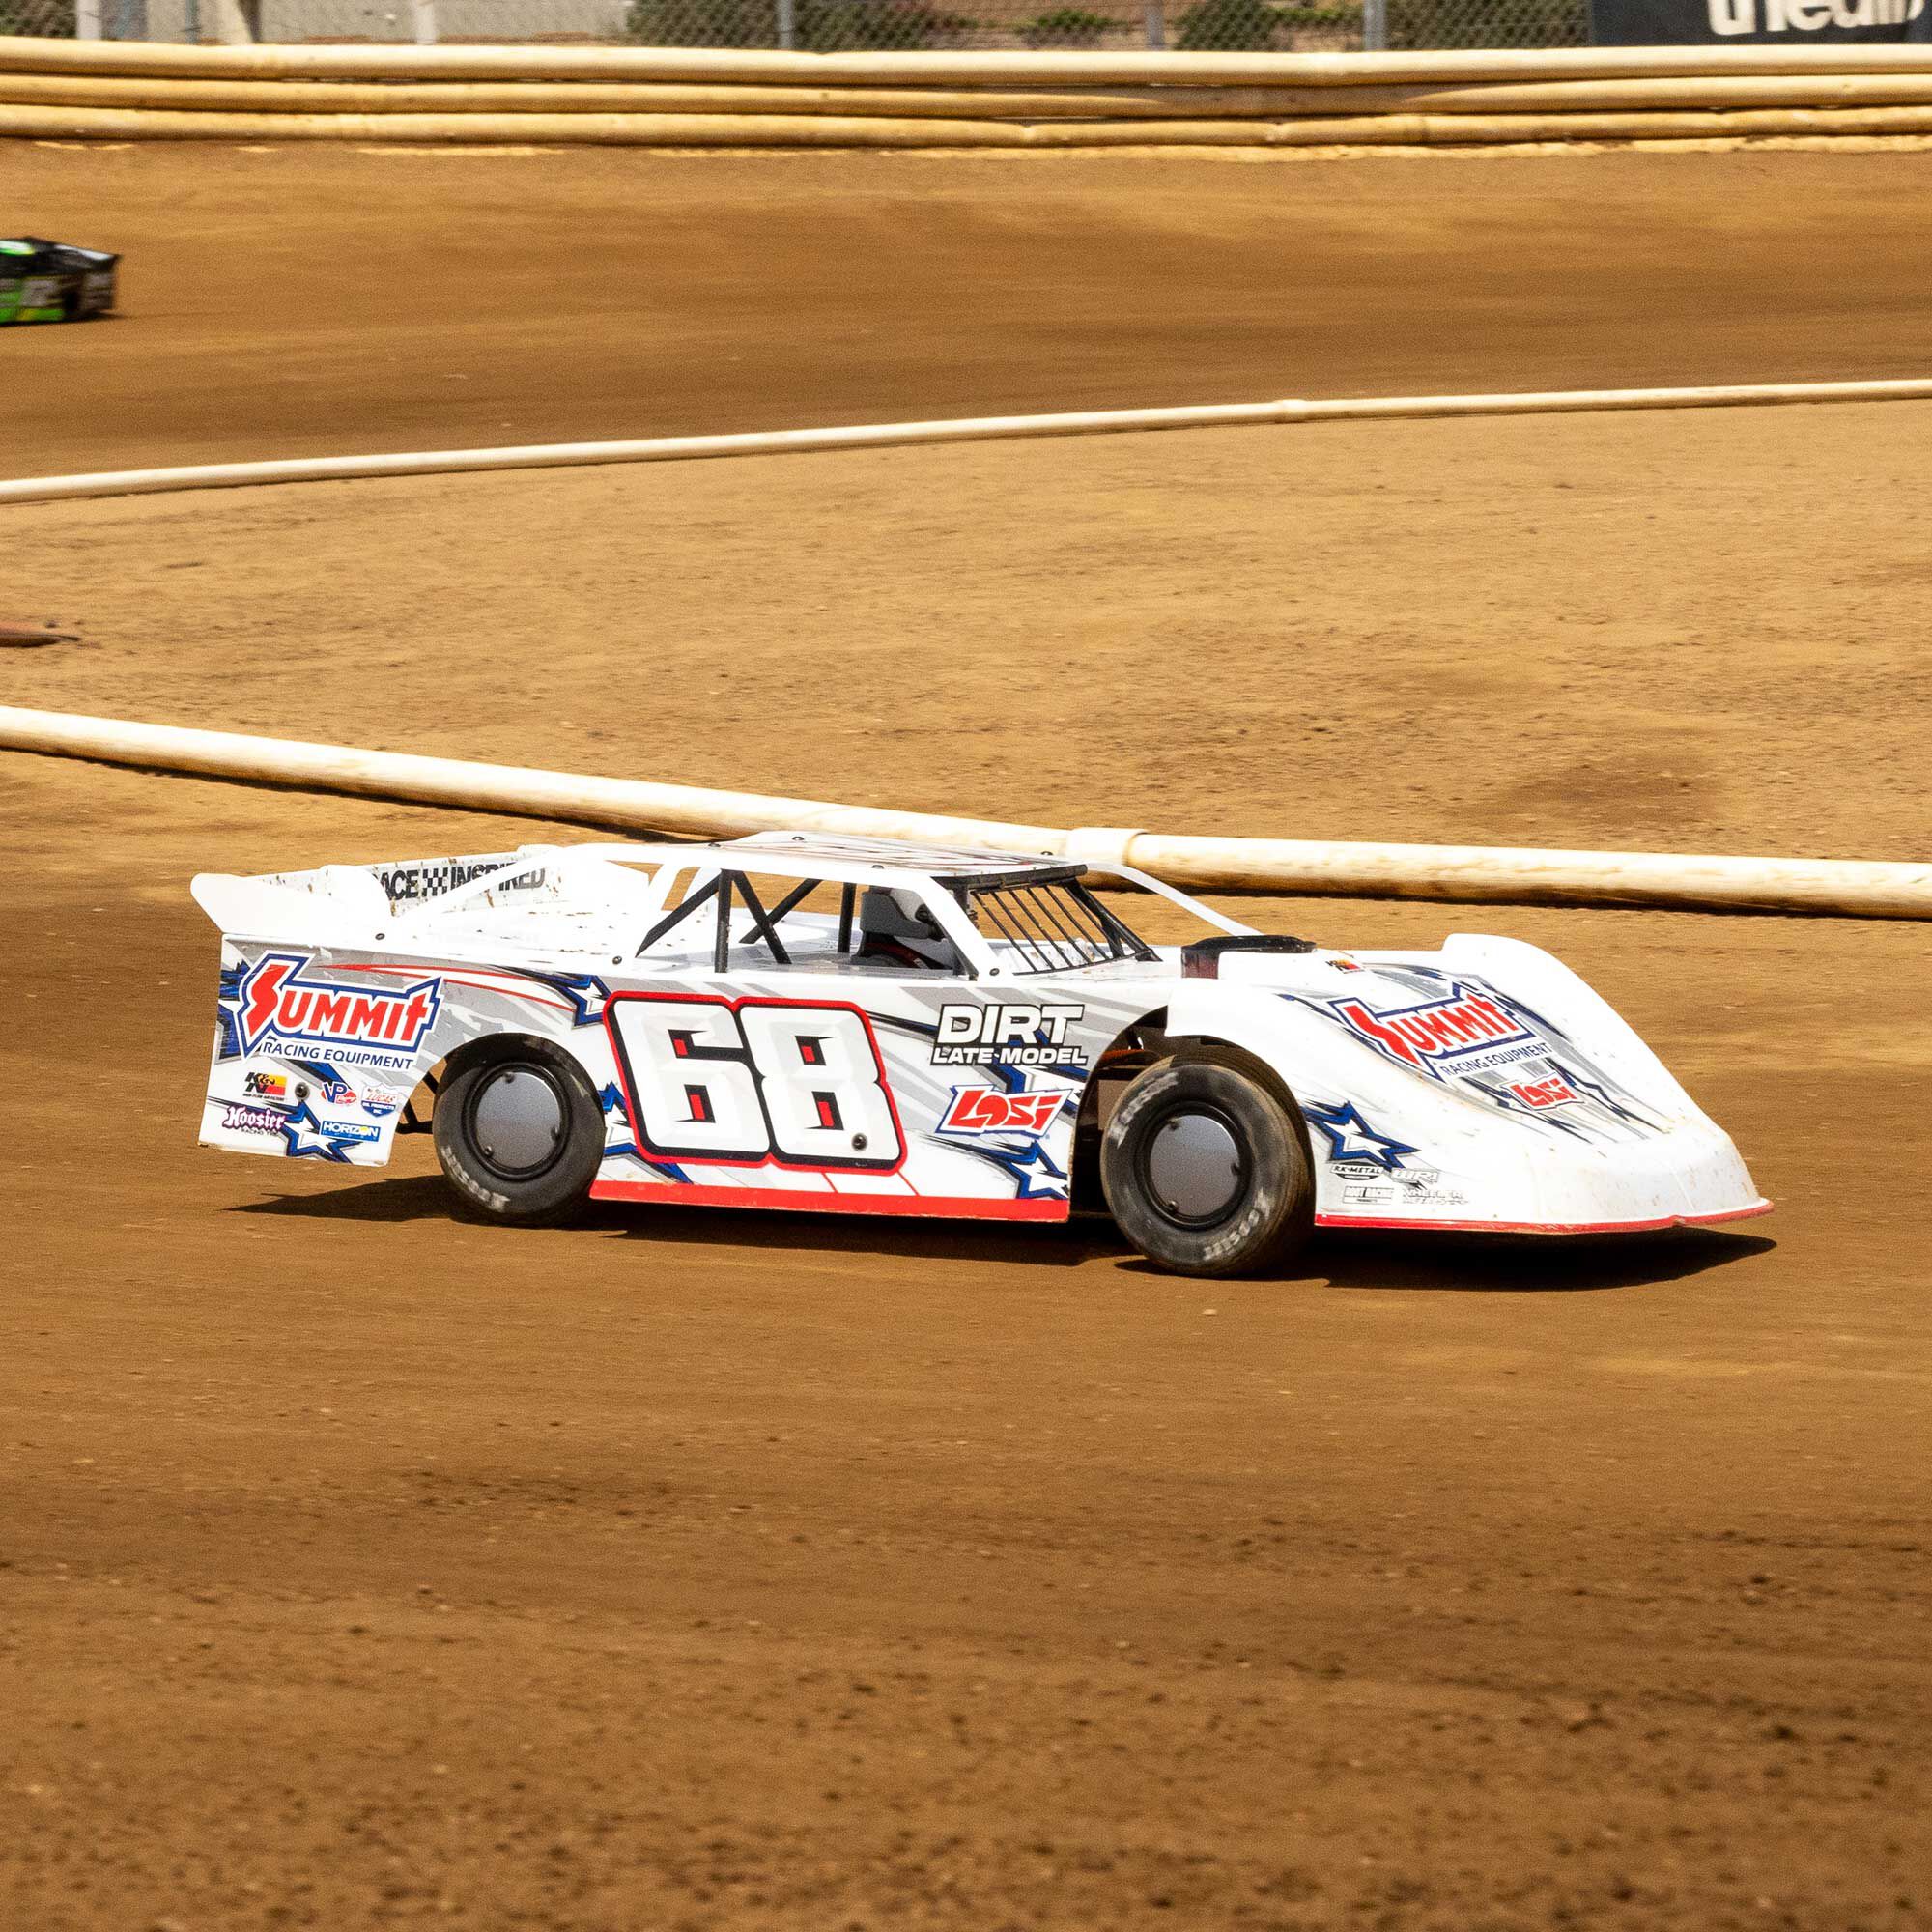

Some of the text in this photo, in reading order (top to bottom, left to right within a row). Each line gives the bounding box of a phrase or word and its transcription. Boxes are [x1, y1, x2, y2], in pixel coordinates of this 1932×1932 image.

[372, 870, 418, 900] ACE
[937, 1004, 1085, 1045] DIRT
[263, 1041, 413, 1069] RACING EQUIPMENT
[930, 1046, 1089, 1065] LATE MODEL
[1439, 1042, 1553, 1075] RACING EQUIPMENT
[323, 1082, 348, 1103] VP
[609, 996, 904, 1170] 68
[222, 1105, 287, 1132] Hoosier
[323, 1122, 380, 1138] HORIZON
